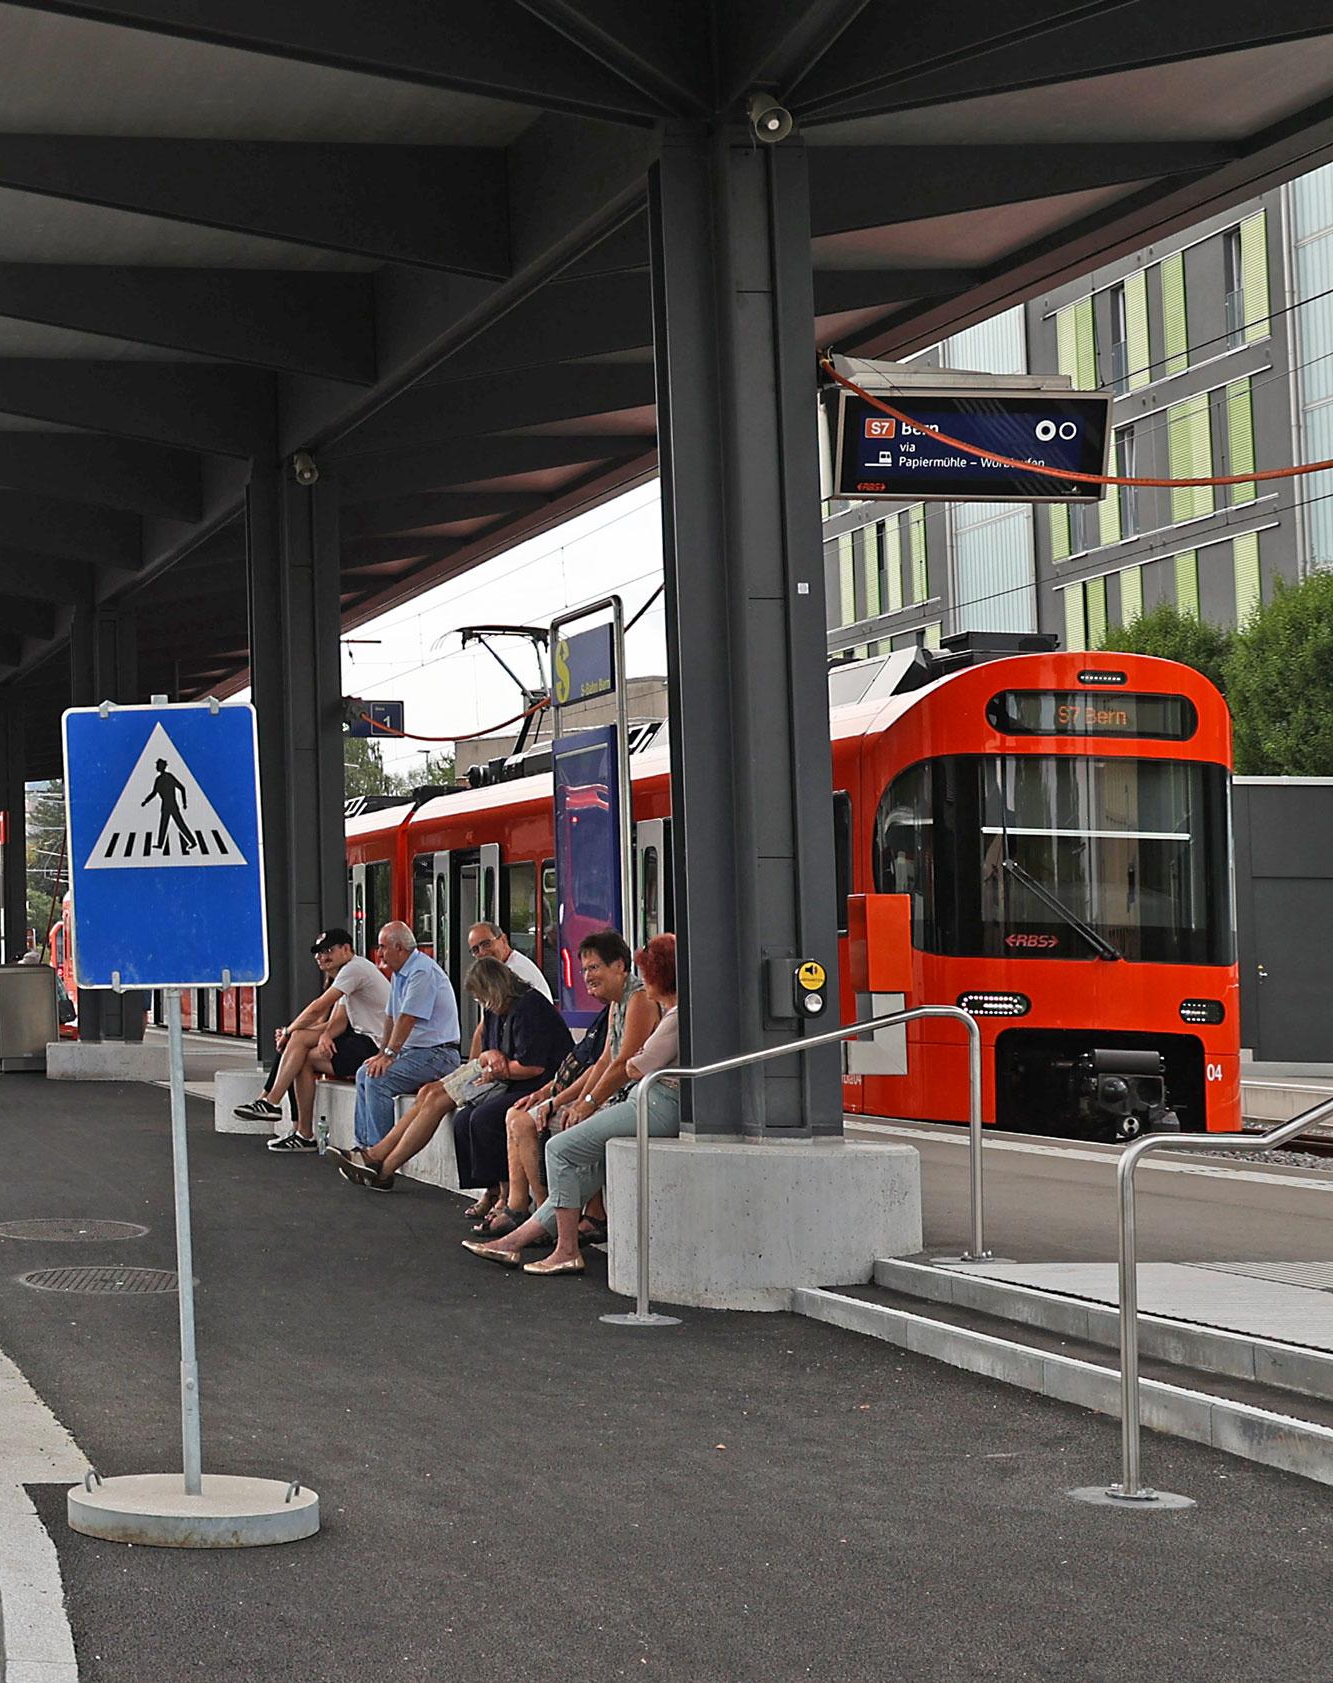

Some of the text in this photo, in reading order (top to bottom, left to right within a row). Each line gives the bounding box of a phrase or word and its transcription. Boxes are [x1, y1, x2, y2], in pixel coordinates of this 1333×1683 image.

[871, 421, 889, 435] S7
[899, 442, 916, 452] via
[899, 456, 967, 469] Papiermühle
[1058, 705, 1127, 725] S7 Bern
[1207, 1063, 1222, 1081] 04
